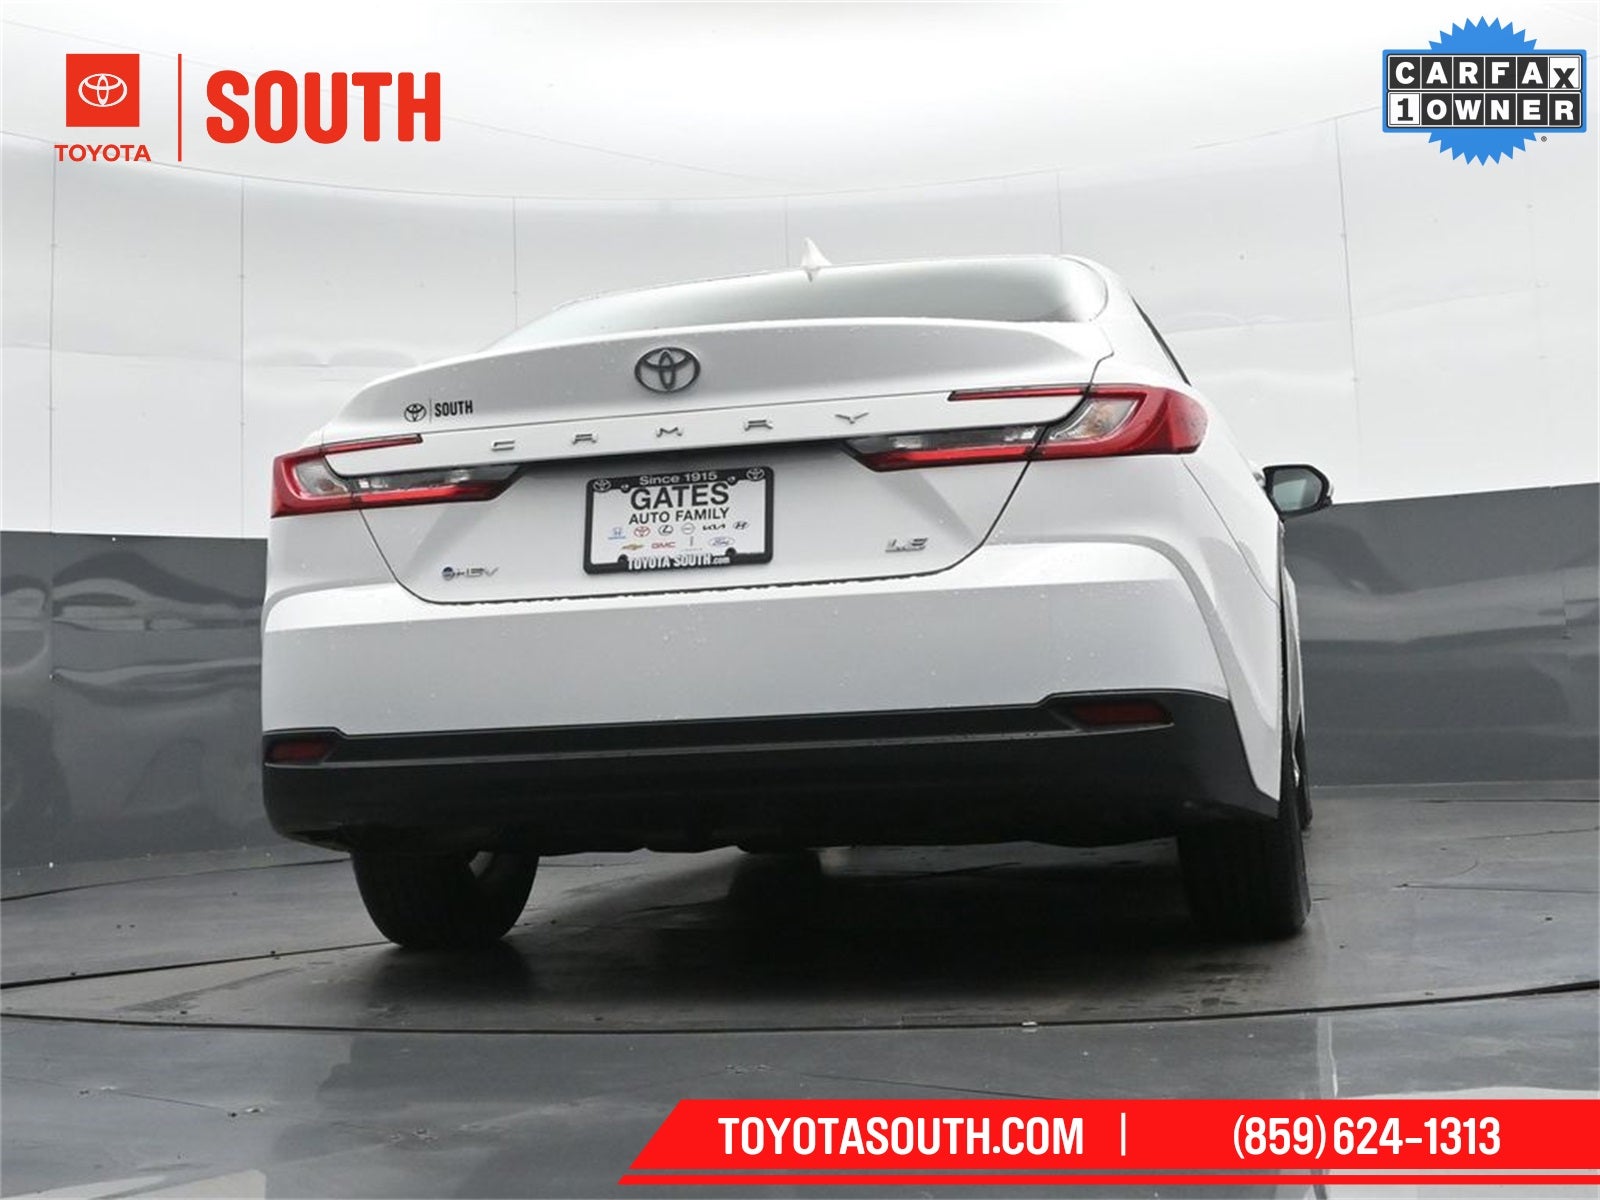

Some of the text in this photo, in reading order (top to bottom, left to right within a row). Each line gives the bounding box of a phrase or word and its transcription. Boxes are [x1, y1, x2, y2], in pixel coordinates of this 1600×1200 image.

[434, 400, 473, 417] SOUTH
[639, 472, 718, 486] Since 1915
[630, 482, 729, 511] GATES
[629, 507, 730, 525] AUTO FAMILY
[651, 541, 676, 549] GMC
[627, 555, 671, 570] TOYOTA
